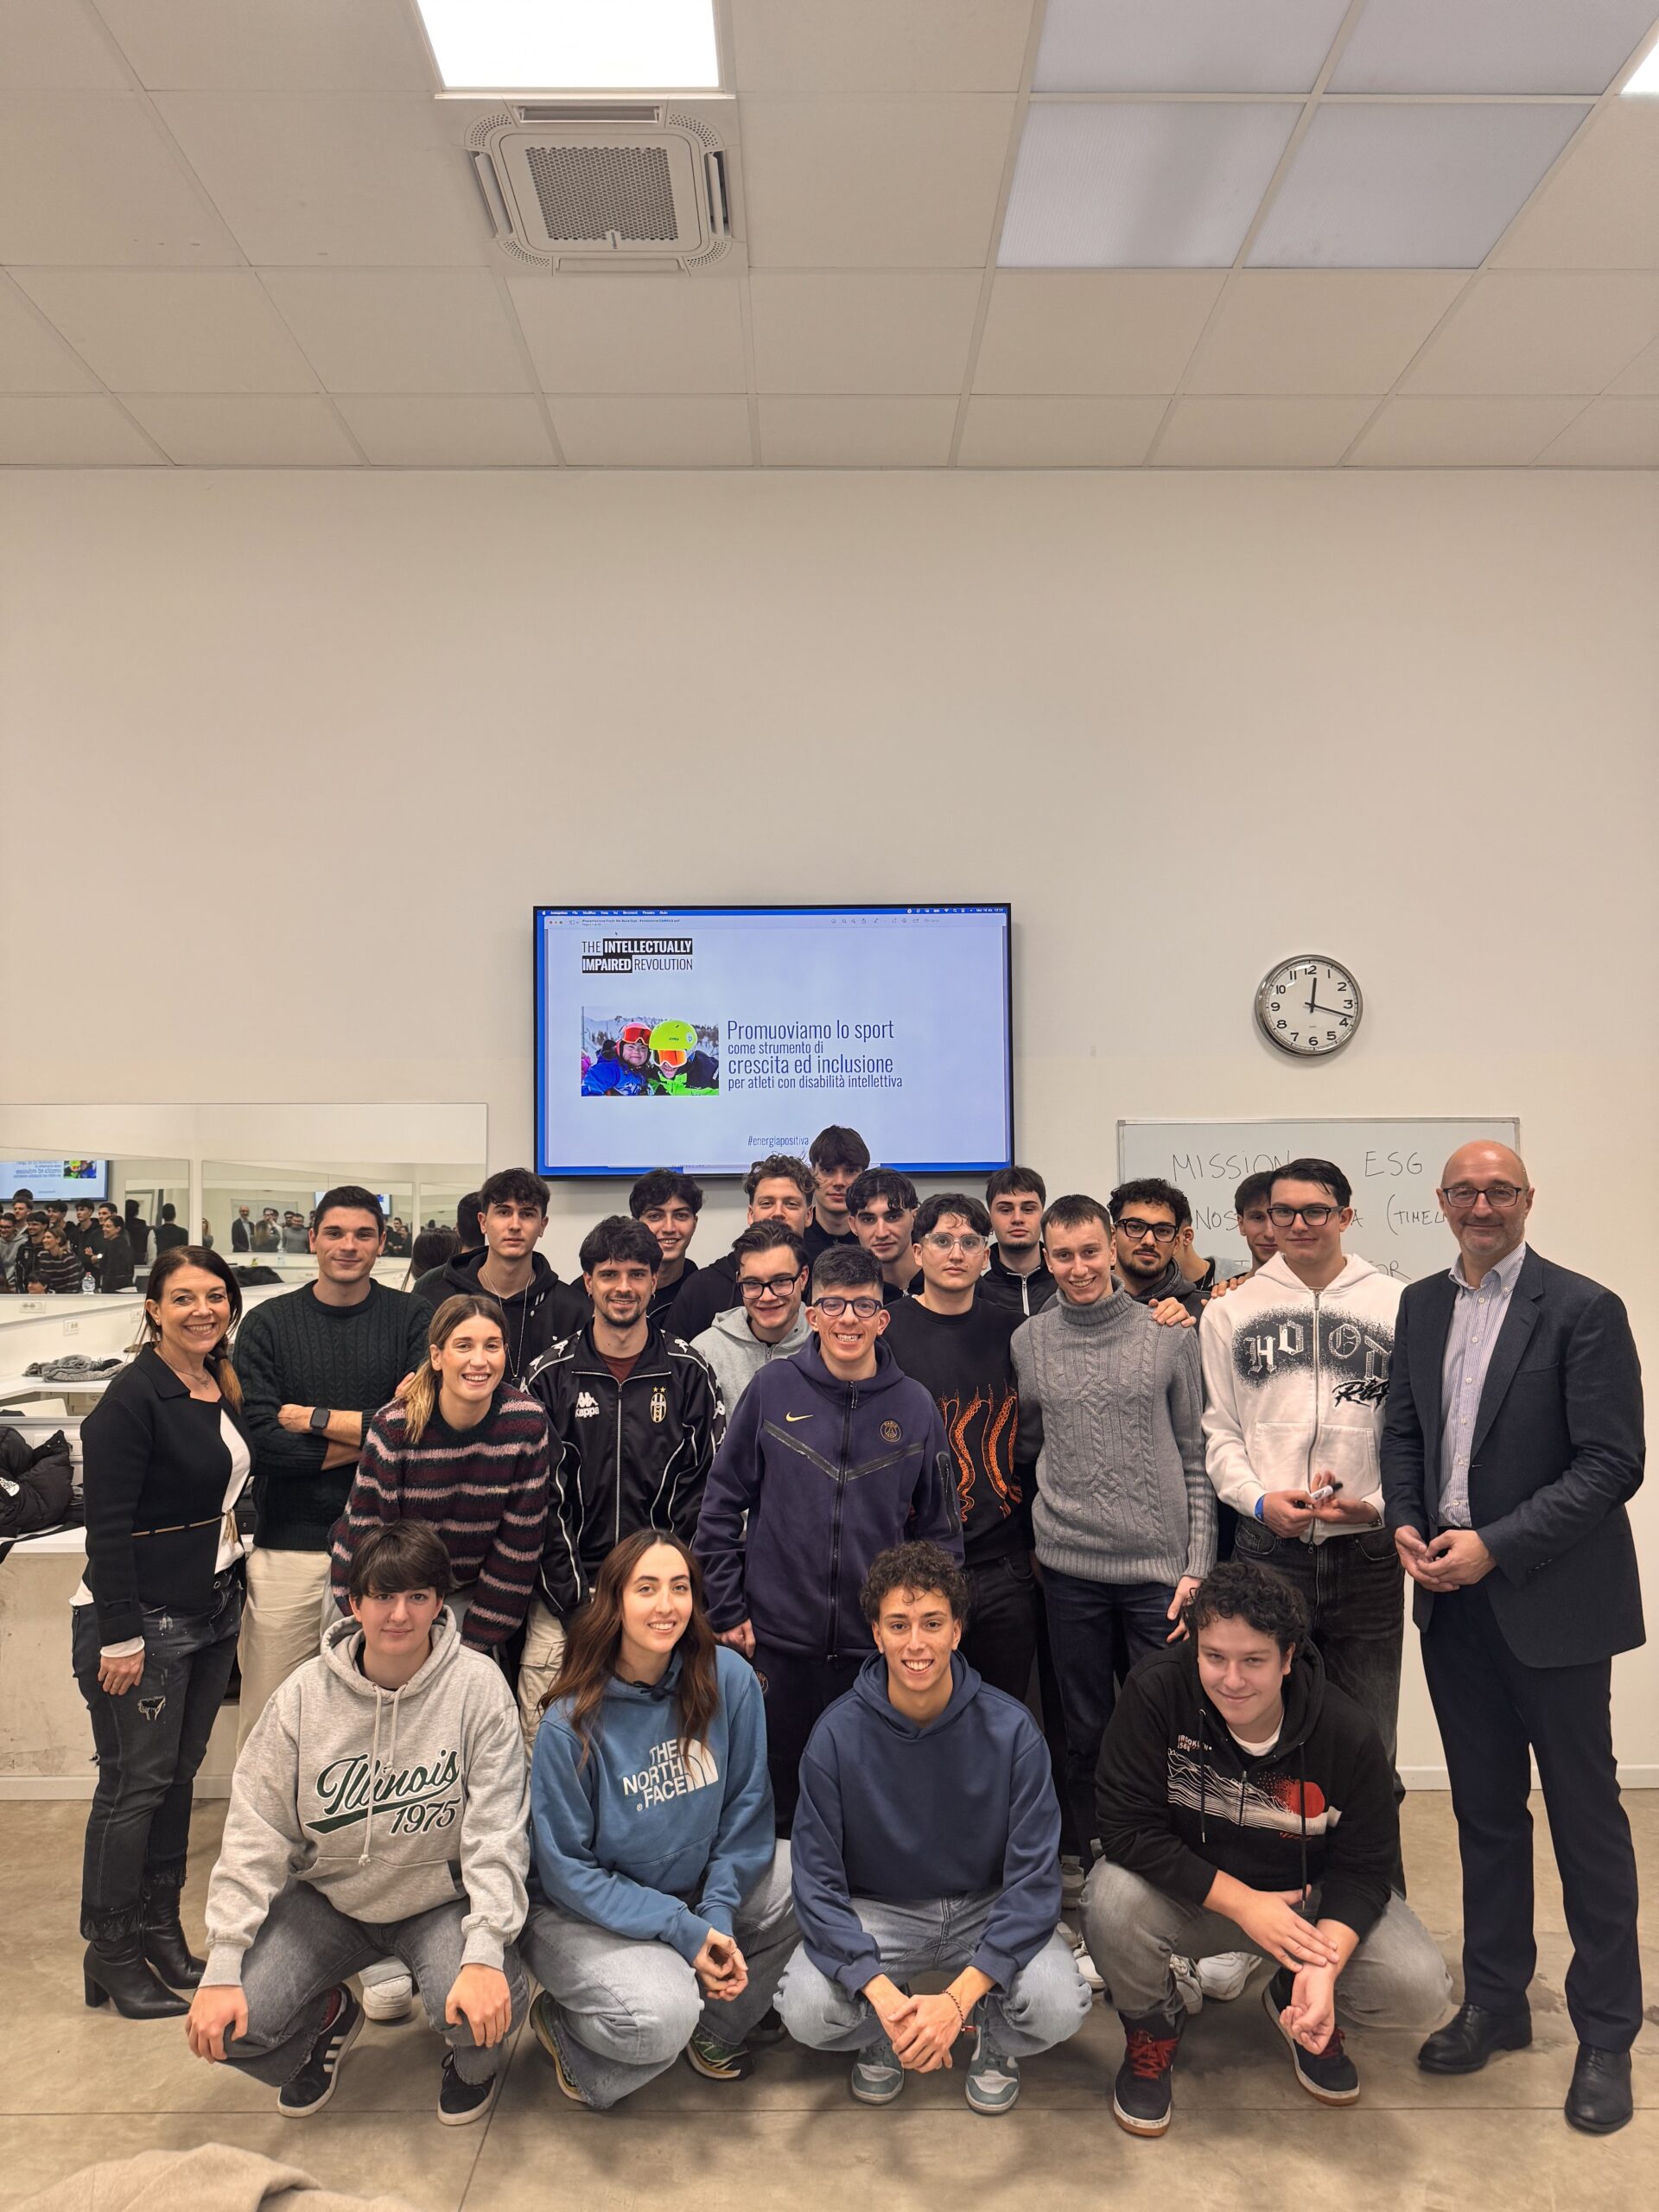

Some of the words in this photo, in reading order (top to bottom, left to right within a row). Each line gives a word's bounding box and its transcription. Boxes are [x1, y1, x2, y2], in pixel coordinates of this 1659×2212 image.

[582, 940, 601, 953] THE
[604, 940, 692, 954] INTELLECTUALLY
[582, 958, 632, 971] IMPAIRED
[634, 958, 693, 970] REVOLUTION
[1304, 965, 1317, 975] 12
[1289, 970, 1297, 980] 11
[1275, 985, 1286, 995] 10
[1337, 982, 1347, 992] 2
[1270, 1002, 1281, 1012] 9
[1343, 999, 1353, 1009] 3
[1276, 1020, 1287, 1029] 8
[1338, 1017, 1349, 1027] 4
[728, 1020, 831, 1039] Promuoviamo
[836, 1020, 849, 1039] lo
[855, 1020, 894, 1043] sport
[1290, 1032, 1300, 1042] 7
[1326, 1031, 1337, 1040] 5
[728, 1043, 756, 1054] come
[759, 1042, 811, 1054] strumento
[814, 1041, 823, 1053] di
[1308, 1037, 1319, 1046] 6
[728, 1056, 789, 1074] crescita
[794, 1055, 811, 1073] ed
[817, 1054, 893, 1073] inclusione
[728, 1077, 745, 1091] per
[748, 1076, 774, 1089] atleti
[778, 1077, 796, 1089] con
[799, 1075, 845, 1088] disabilità
[849, 1074, 902, 1088] intellettiva
[747, 1135, 809, 1147] #energiapositiva
[1365, 1151, 1422, 1177] ESG
[649, 1738, 677, 1765] THE
[316, 1749, 461, 1815] Illinois
[622, 1757, 683, 1796] NORTH
[643, 1776, 688, 1808] FACE
[390, 1797, 461, 1835] 1975
